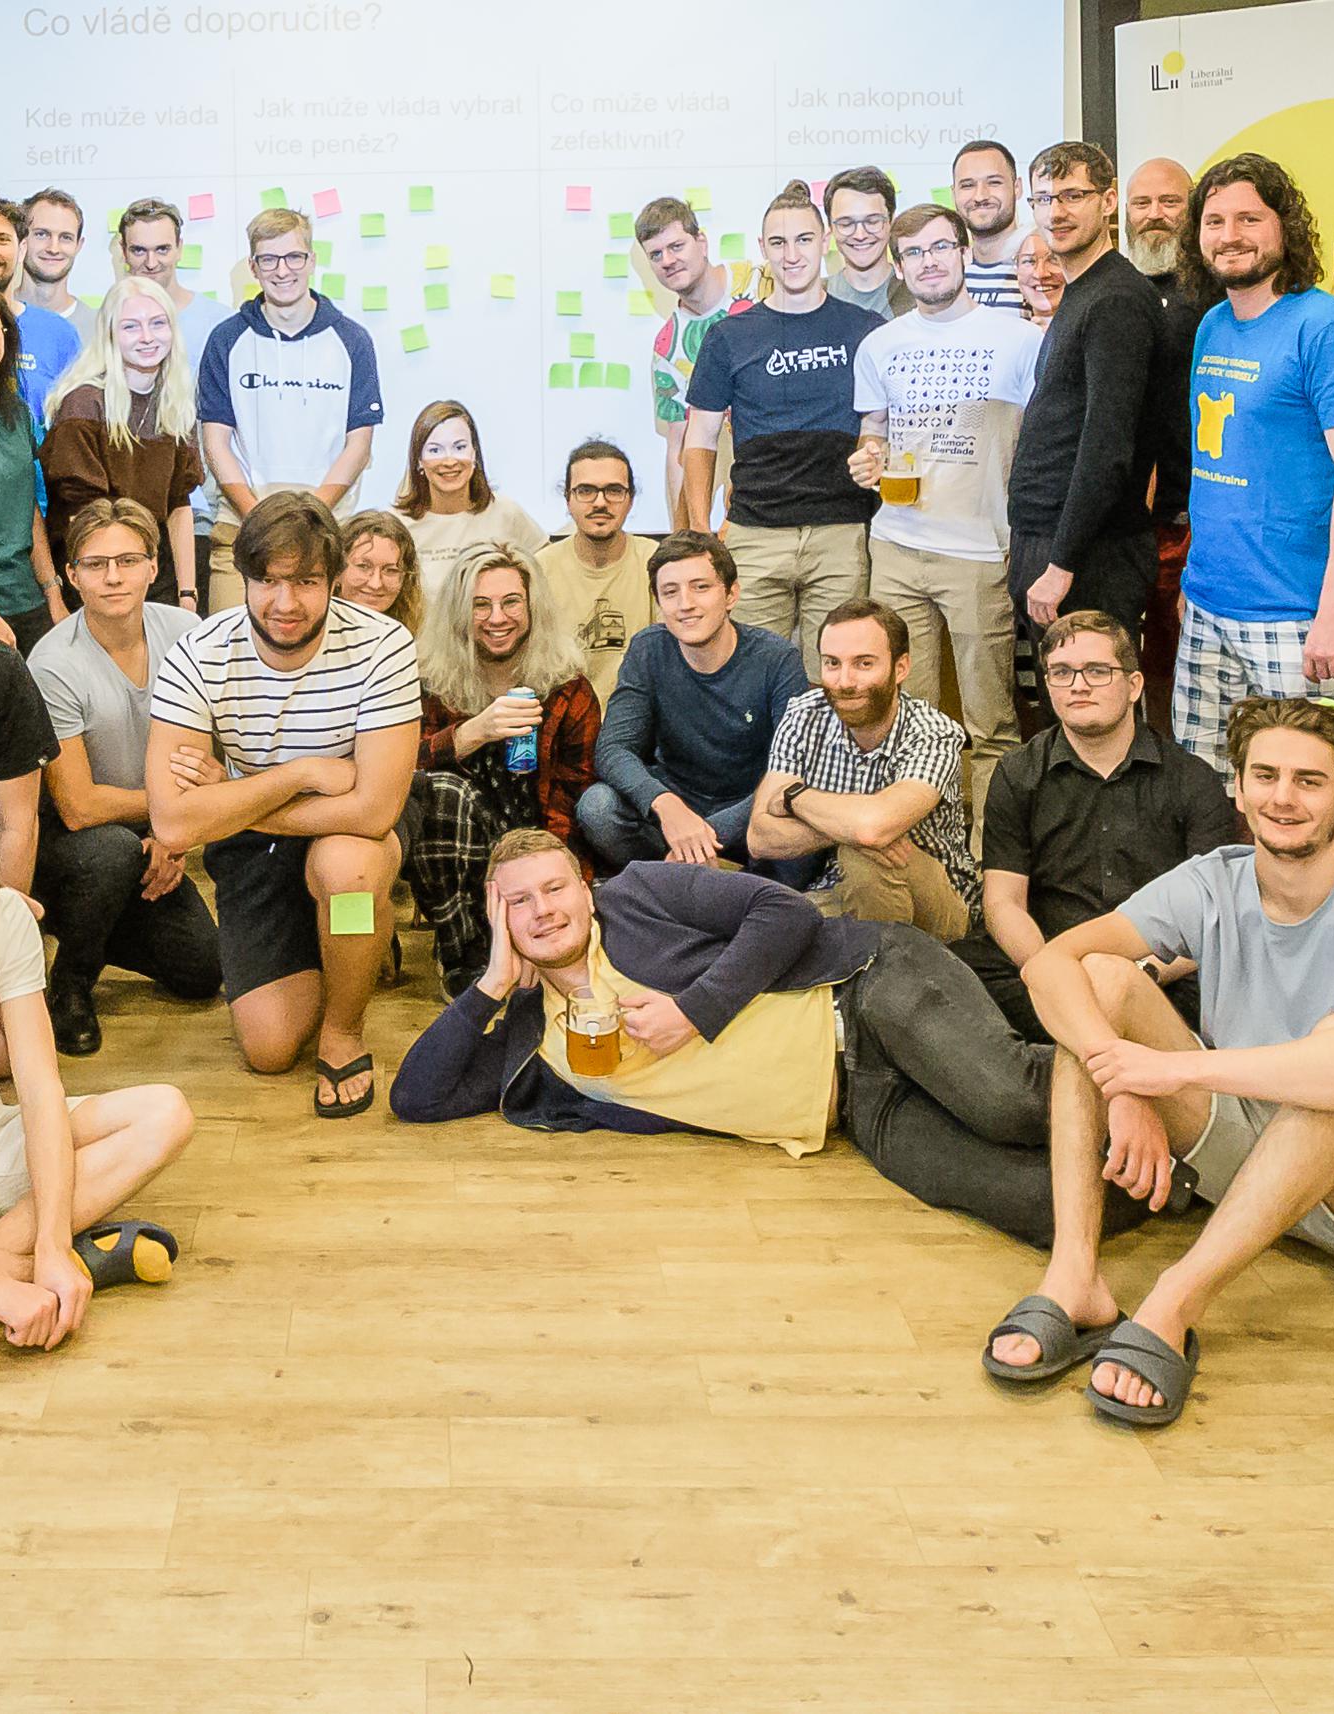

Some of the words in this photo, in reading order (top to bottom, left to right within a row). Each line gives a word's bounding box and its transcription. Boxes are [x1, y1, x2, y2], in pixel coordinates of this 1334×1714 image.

[23, 7, 70, 37] Co
[82, 4, 172, 35] vládě
[184, 3, 382, 41] doporučíte?
[253, 97, 294, 118] Jak
[303, 96, 369, 118] může
[376, 95, 441, 117] vláda
[449, 94, 522, 121] vybrat
[550, 93, 584, 113] Co
[593, 91, 658, 112] může
[666, 91, 730, 112] vláda
[787, 87, 828, 108] Jak
[837, 85, 964, 112] nakopnout
[26, 106, 72, 128] Kde
[81, 105, 146, 128] může
[155, 104, 218, 127] vláda
[254, 134, 303, 155] více
[312, 131, 399, 159] peněz?
[549, 128, 685, 151] zefektivnit?
[787, 123, 931, 150] ekonomický
[938, 122, 998, 144] růst?
[27, 144, 99, 166] šetřit?
